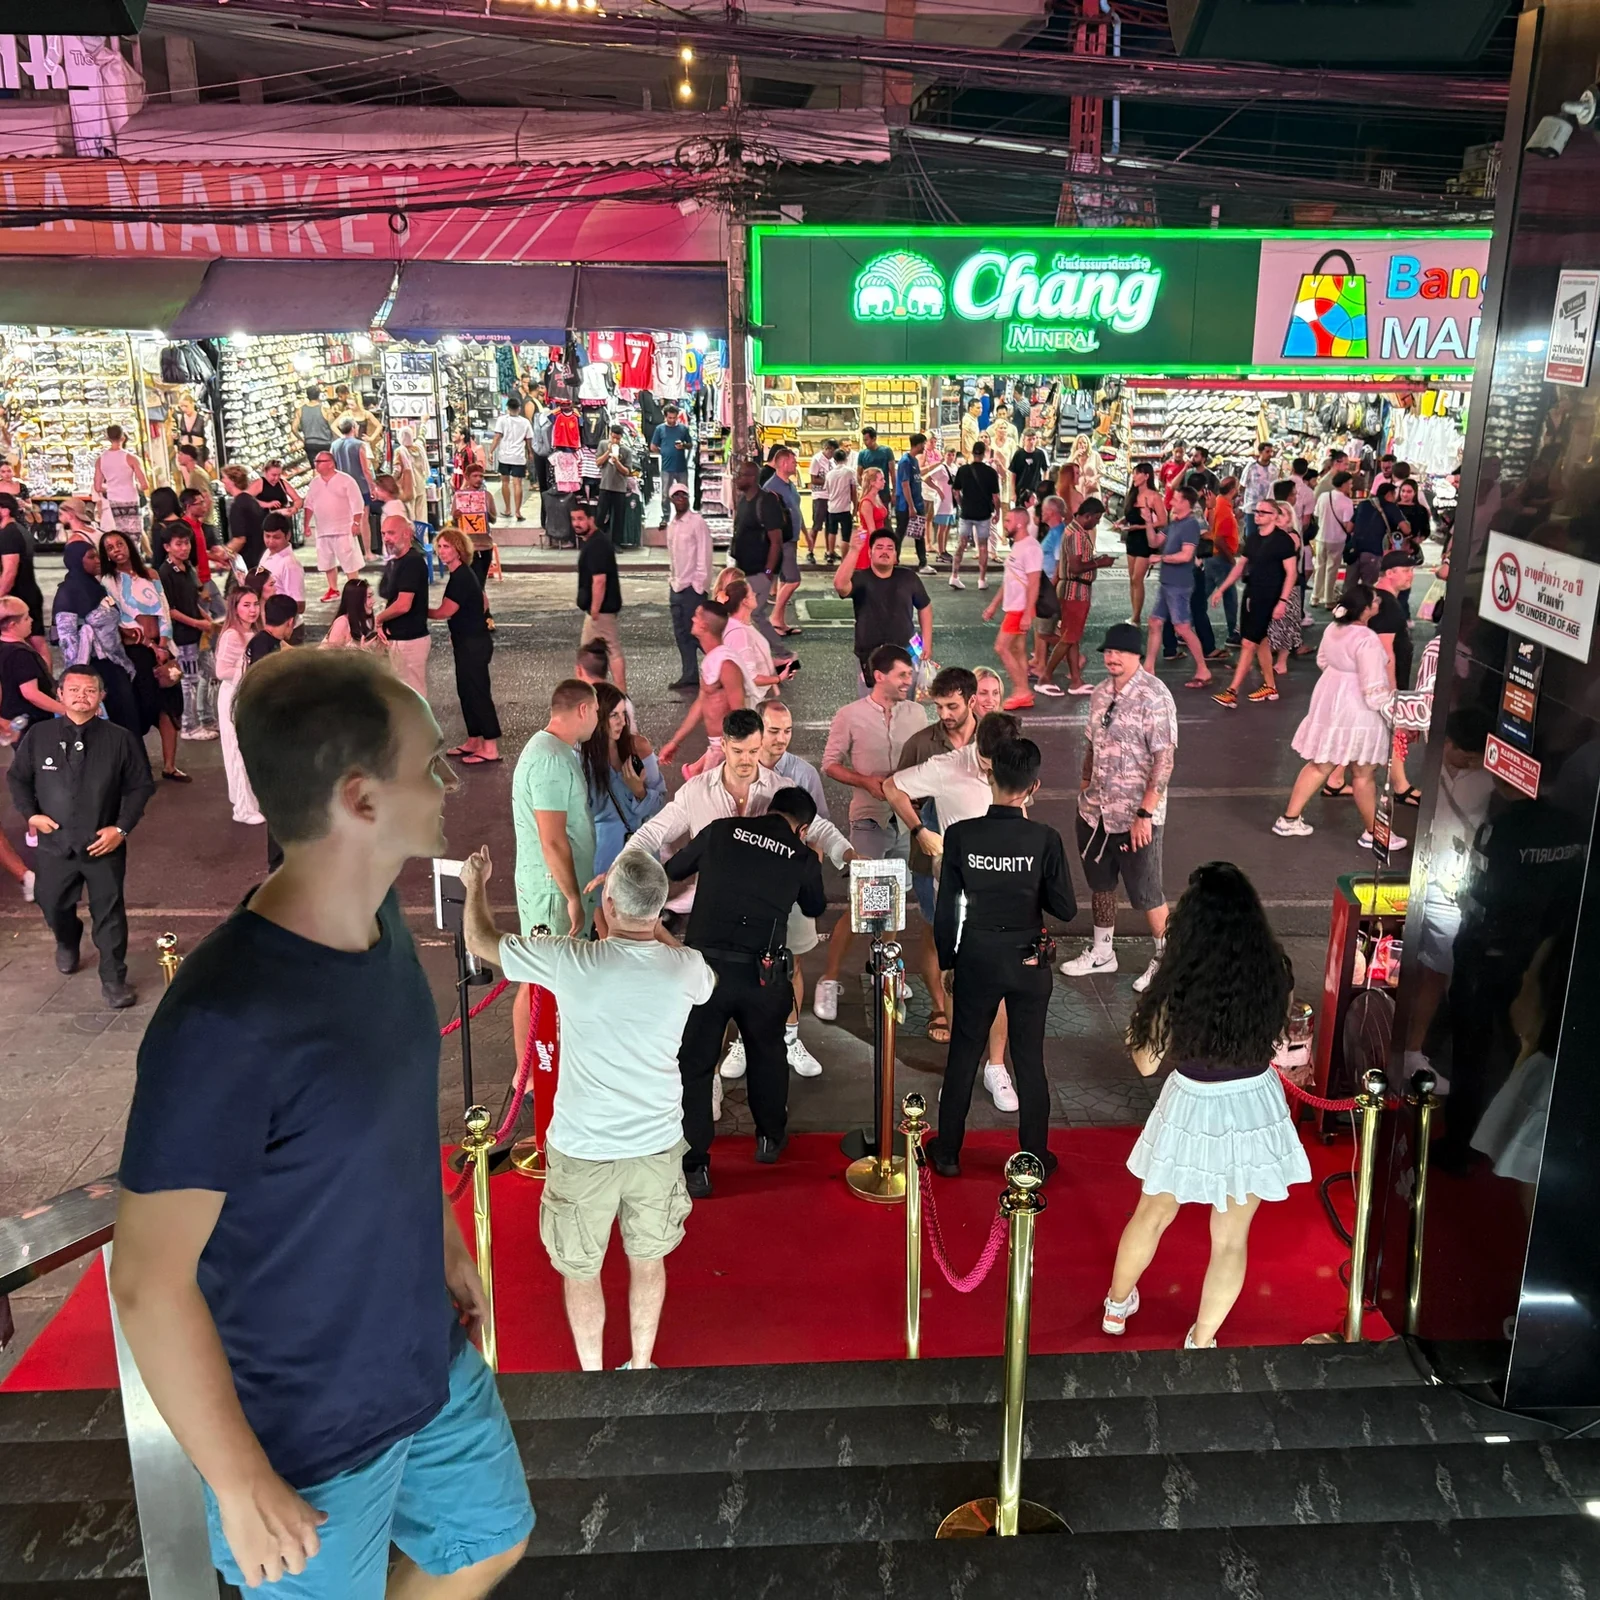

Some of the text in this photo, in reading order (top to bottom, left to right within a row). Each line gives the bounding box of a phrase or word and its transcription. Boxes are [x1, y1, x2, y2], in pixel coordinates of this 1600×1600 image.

[106, 171, 420, 254] MARKET
[952, 251, 1162, 332] Chang
[1386, 255, 1487, 306] Ban
[1013, 328, 1099, 352] MINERAL
[631, 347, 642, 368] 7
[667, 360, 674, 378] 3
[589, 418, 597, 433] 7
[1524, 561, 1584, 596] อายุต่ำกว่า 20 ปี
[1498, 585, 1510, 603] 20
[1537, 586, 1564, 611] ห้ามเข้า
[1516, 602, 1580, 636] NO UNDER 20 OF AGE
[1520, 669, 1533, 680] UNDER
[733, 828, 795, 859] SECURITY
[968, 853, 1034, 872] SECURITY
[535, 1040, 552, 1072] Sugar
